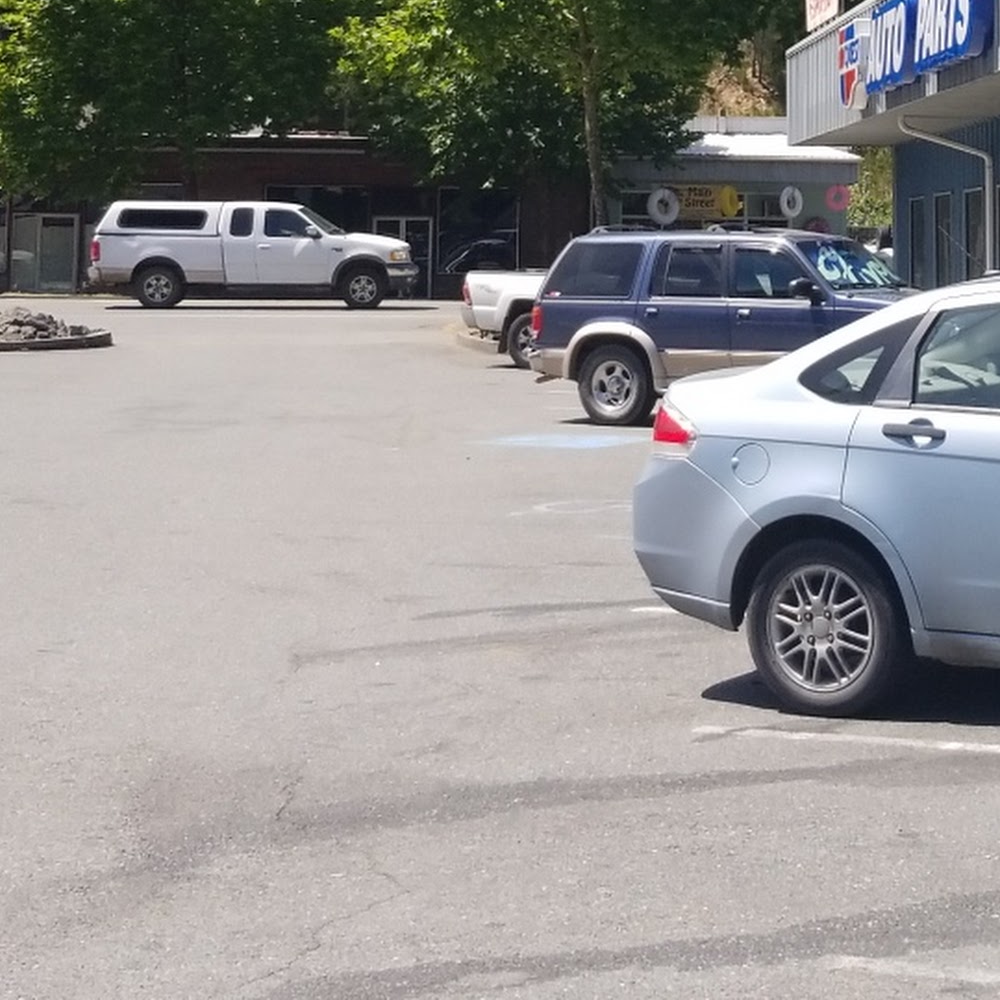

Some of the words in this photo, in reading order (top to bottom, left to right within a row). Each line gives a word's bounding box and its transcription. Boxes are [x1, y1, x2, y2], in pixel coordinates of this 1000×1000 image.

[866, 1, 906, 84] AUTO
[687, 186, 712, 197] Main
[684, 197, 715, 208] Street
